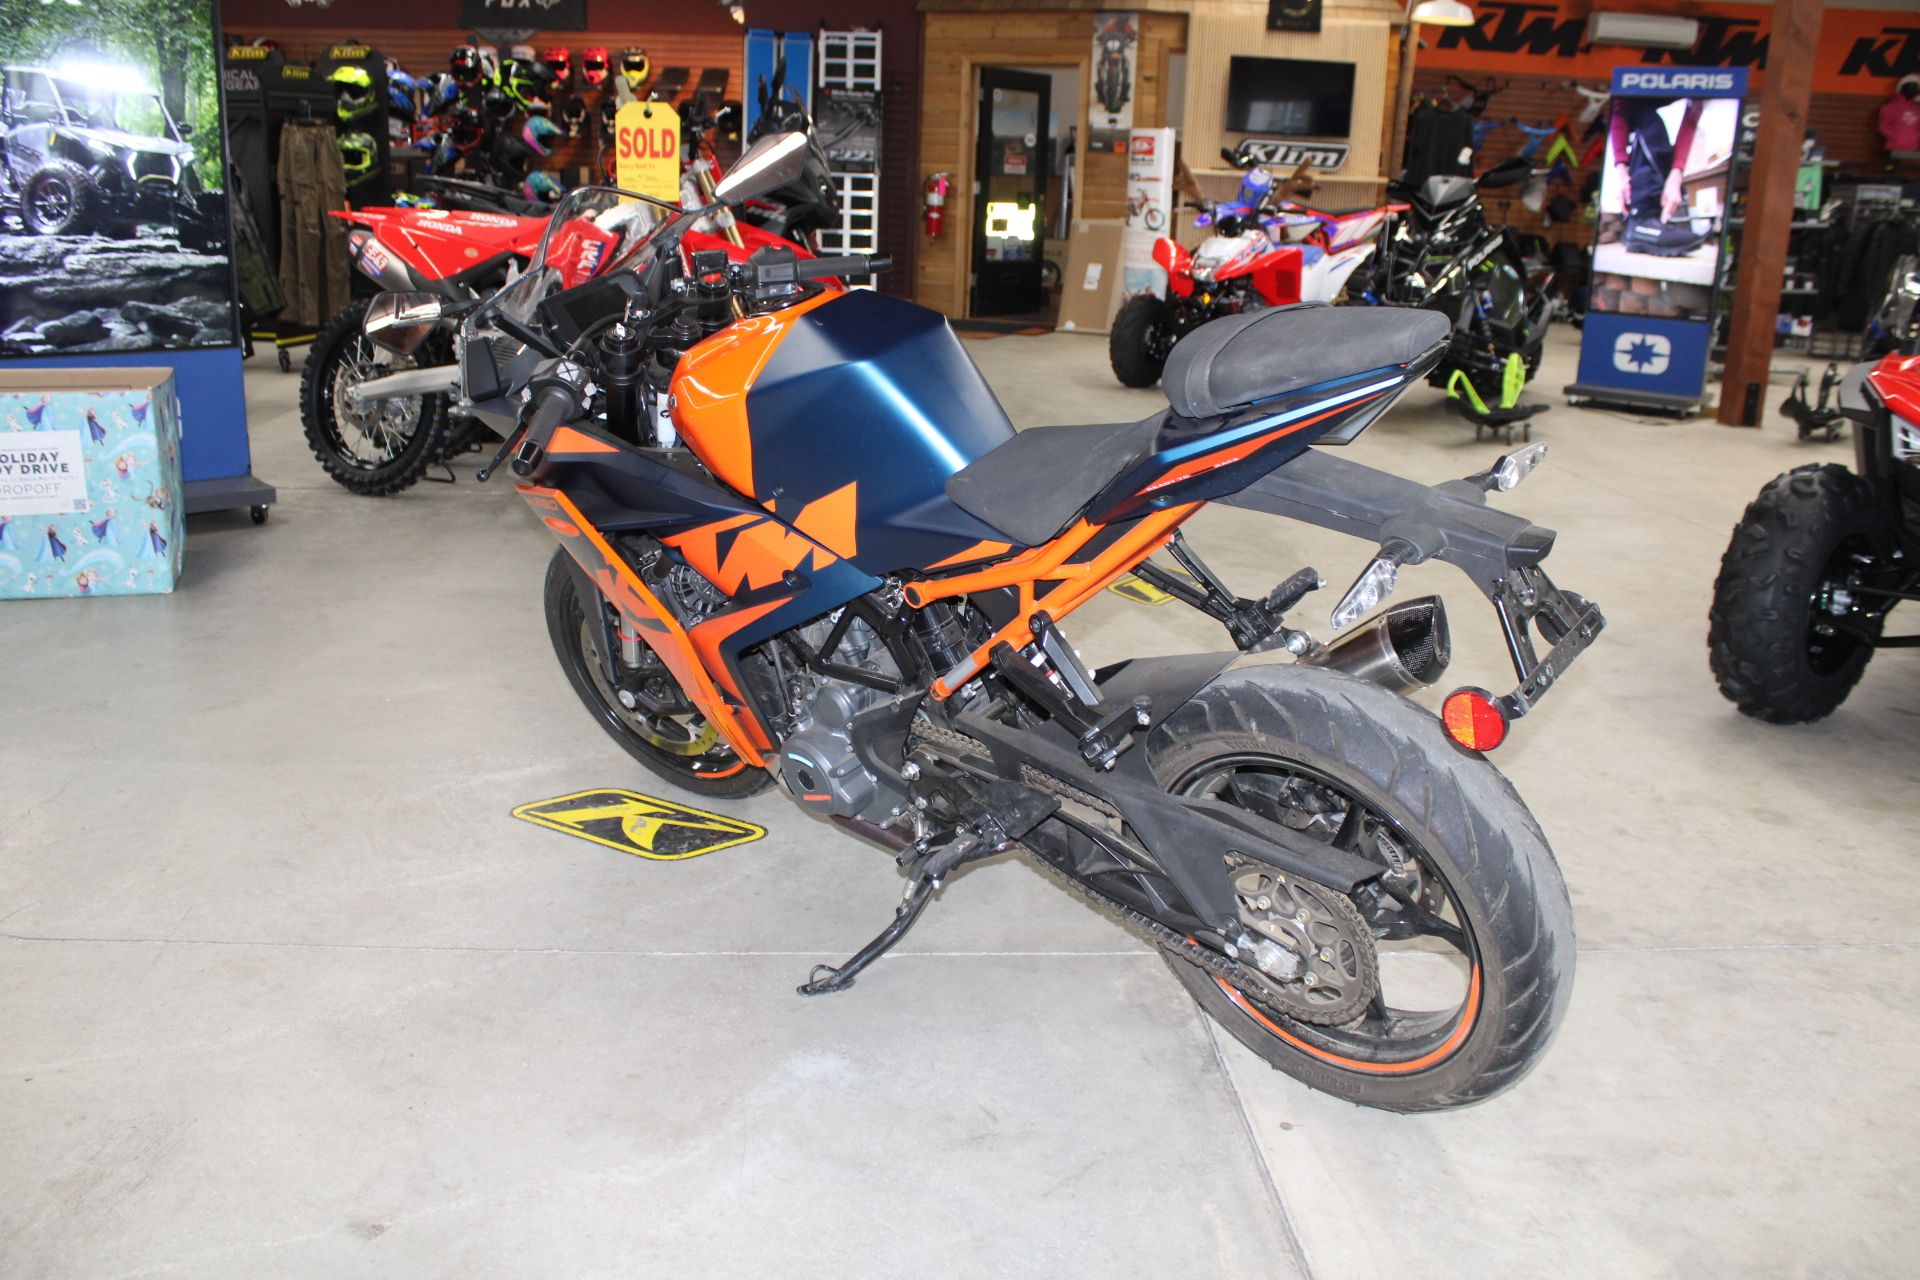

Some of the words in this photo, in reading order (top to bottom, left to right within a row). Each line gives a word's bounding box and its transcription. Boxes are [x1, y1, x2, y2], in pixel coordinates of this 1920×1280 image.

[1437, 2, 1592, 57] KTM
[1838, 27, 1920, 77] KT
[1621, 73, 1734, 90] POLARIS
[619, 127, 675, 159] SOLD
[416, 219, 462, 235] HONDA
[470, 213, 518, 228] HONDA
[0, 465, 13, 475] Y
[20, 463, 69, 474] DRIVE
[0, 482, 62, 495] ROPOFF
[1145, 480, 1175, 492] READY
